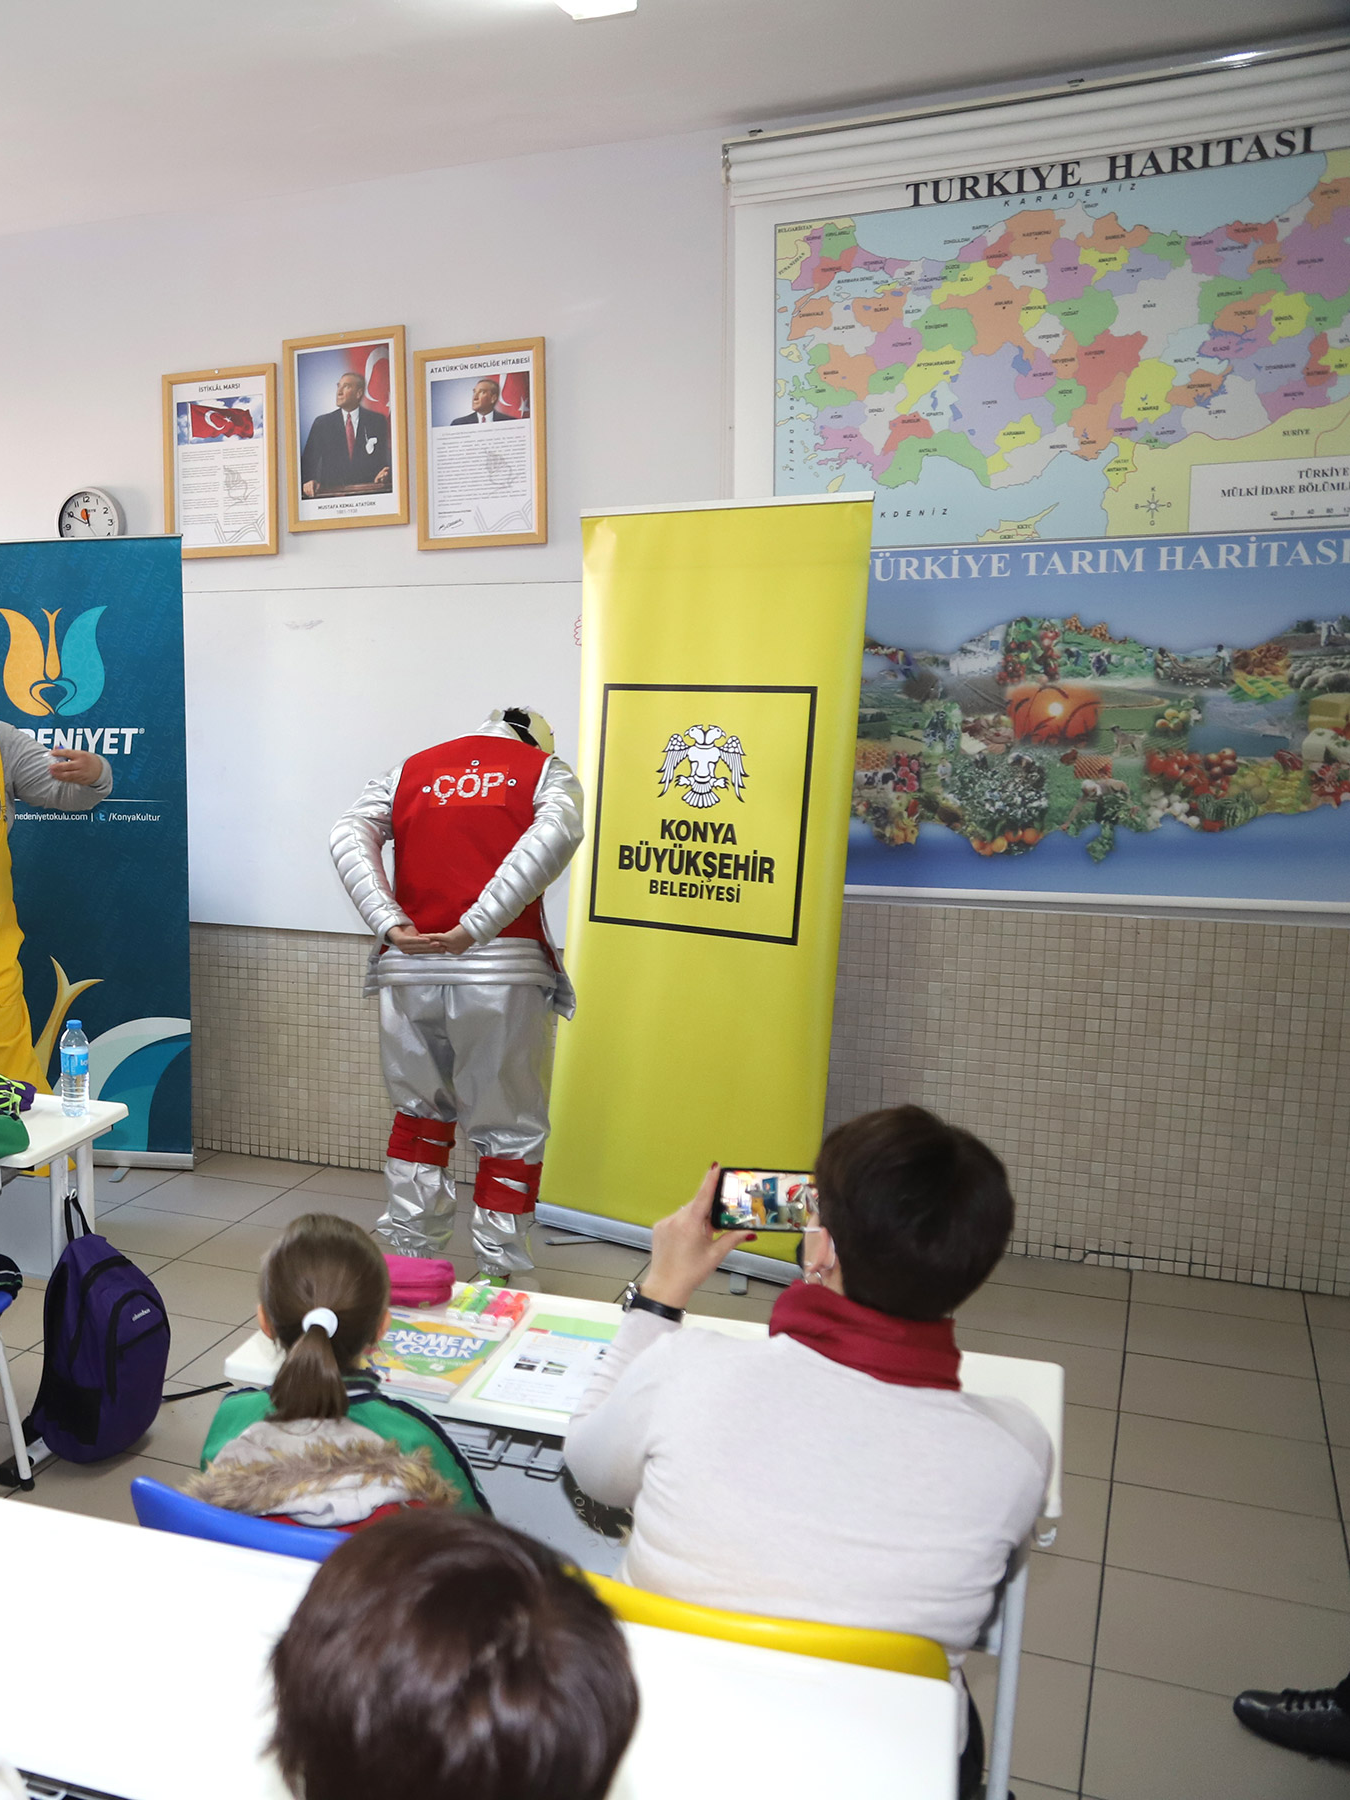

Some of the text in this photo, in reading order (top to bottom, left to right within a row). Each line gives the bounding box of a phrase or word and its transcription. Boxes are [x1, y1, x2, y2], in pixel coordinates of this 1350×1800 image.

[430, 356, 531, 375] ATATÜRK'ÜN GENÇLİĞE HİTABESİ
[1298, 467, 1349, 479] TÜRKİYE
[1221, 487, 1258, 498] MÜLKİ
[1261, 485, 1296, 496] İDARE
[880, 507, 948, 518] KDENİZ
[871, 536, 1350, 582] ÜRKİYE TARIM HARİTASI
[433, 768, 505, 805] ÇÖP
[660, 819, 737, 845] KONYA
[618, 840, 775, 884] BÜYÜKŞEHİR
[649, 879, 741, 903] BELEDİYESİ
[385, 1330, 485, 1351] ENOMEN
